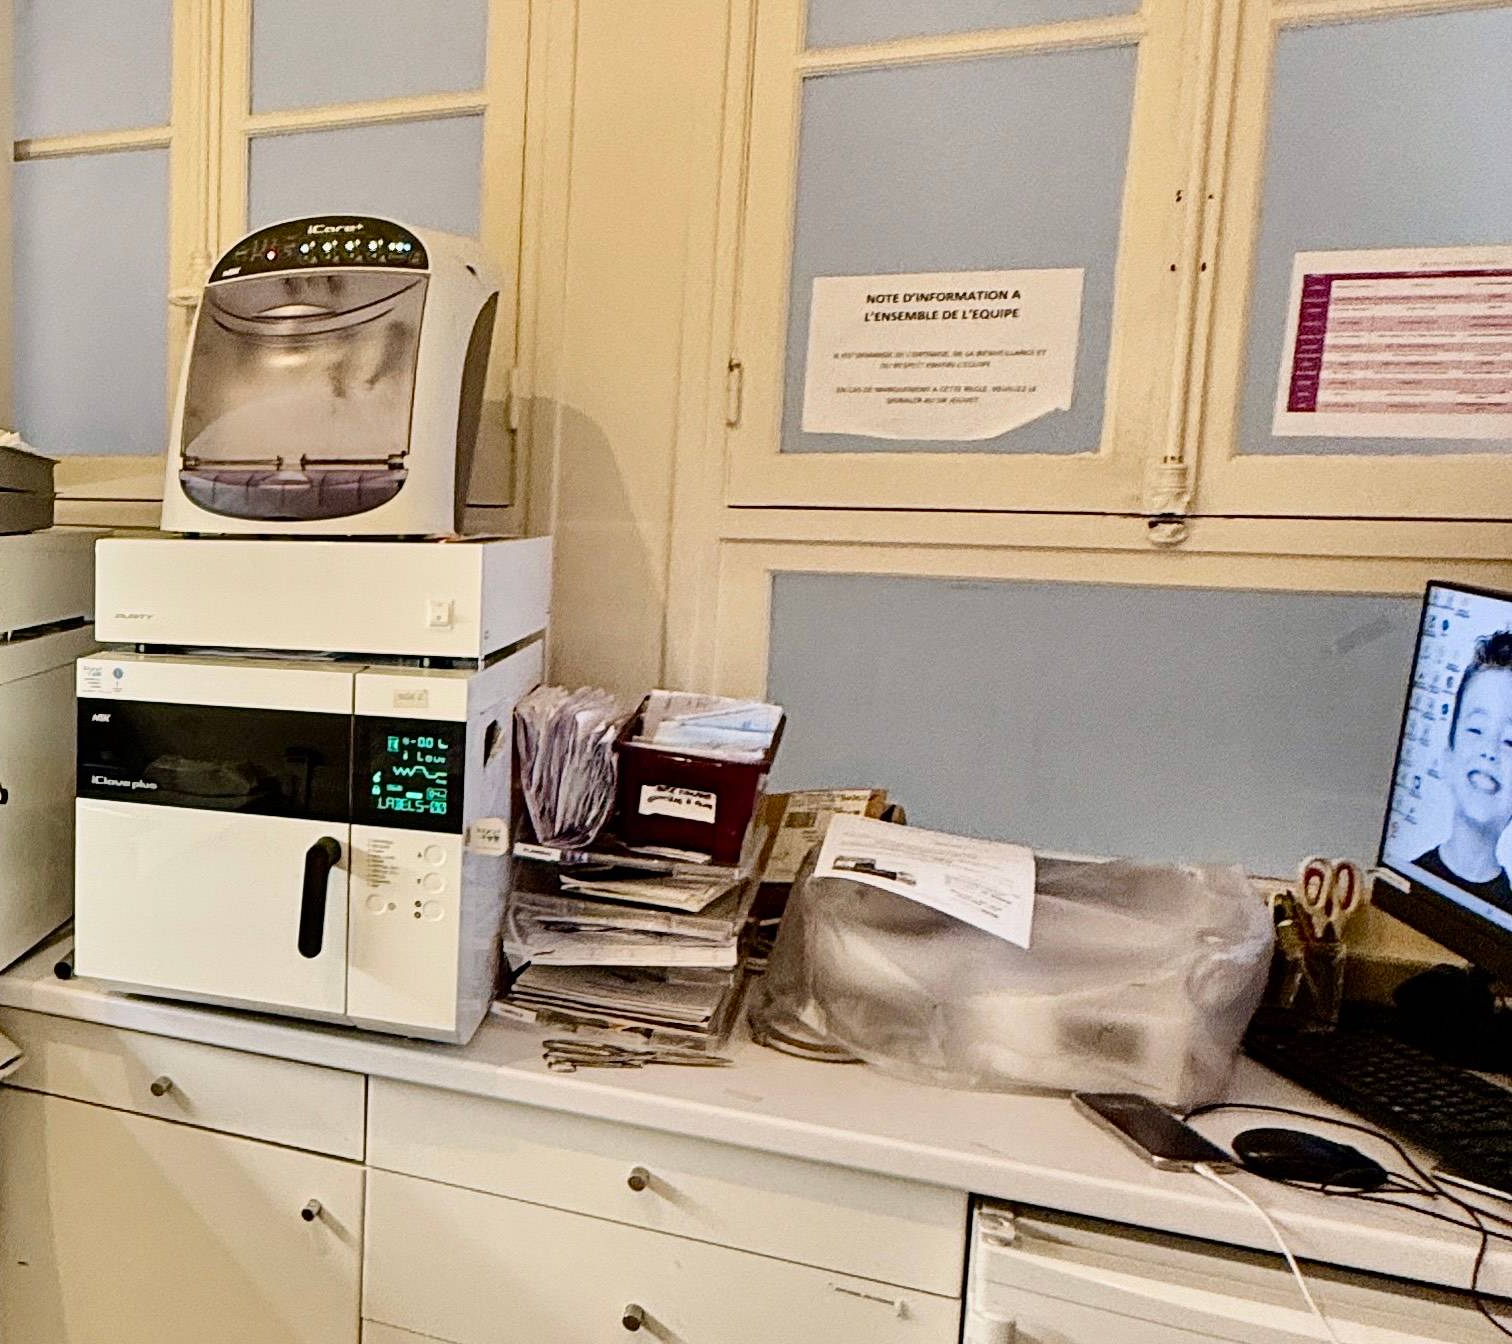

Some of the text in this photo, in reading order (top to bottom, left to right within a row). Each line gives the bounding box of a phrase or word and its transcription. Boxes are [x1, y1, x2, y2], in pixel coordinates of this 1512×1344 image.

[866, 290, 1021, 304] NOTE D'INFORMATION A
[864, 308, 1020, 322] L'ENSEMBLE DE L'EQUIPE
